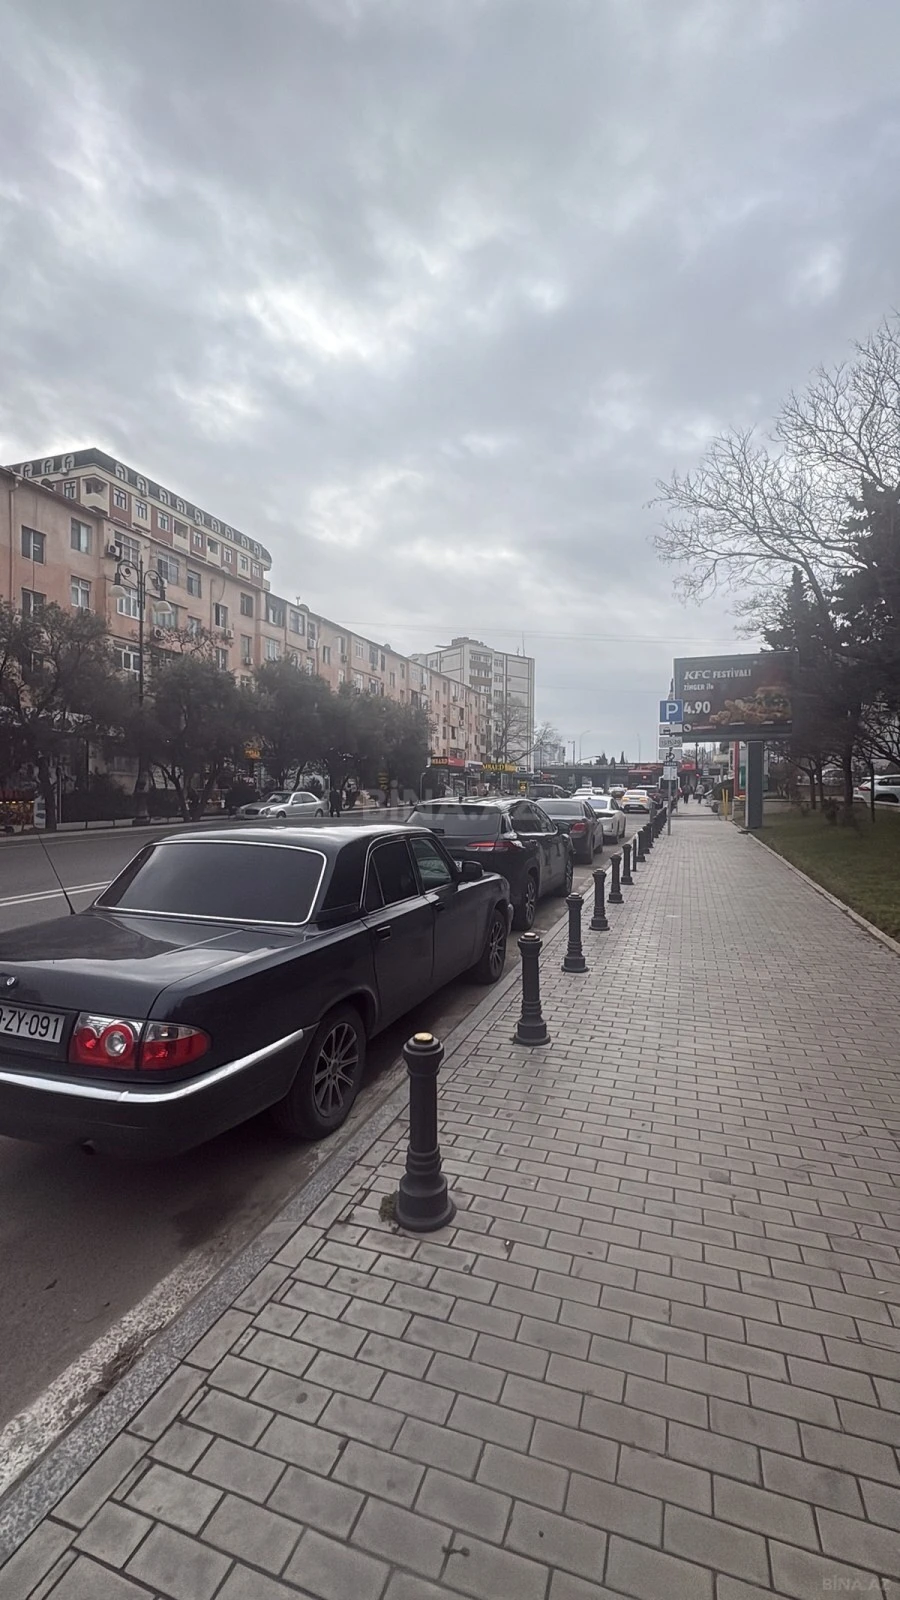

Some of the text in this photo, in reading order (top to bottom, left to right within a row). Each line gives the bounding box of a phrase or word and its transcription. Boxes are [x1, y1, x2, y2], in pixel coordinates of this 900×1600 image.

[684, 668, 752, 680] KFC FESTİVALI
[666, 702, 679, 721] P
[683, 701, 711, 714] 4.90
